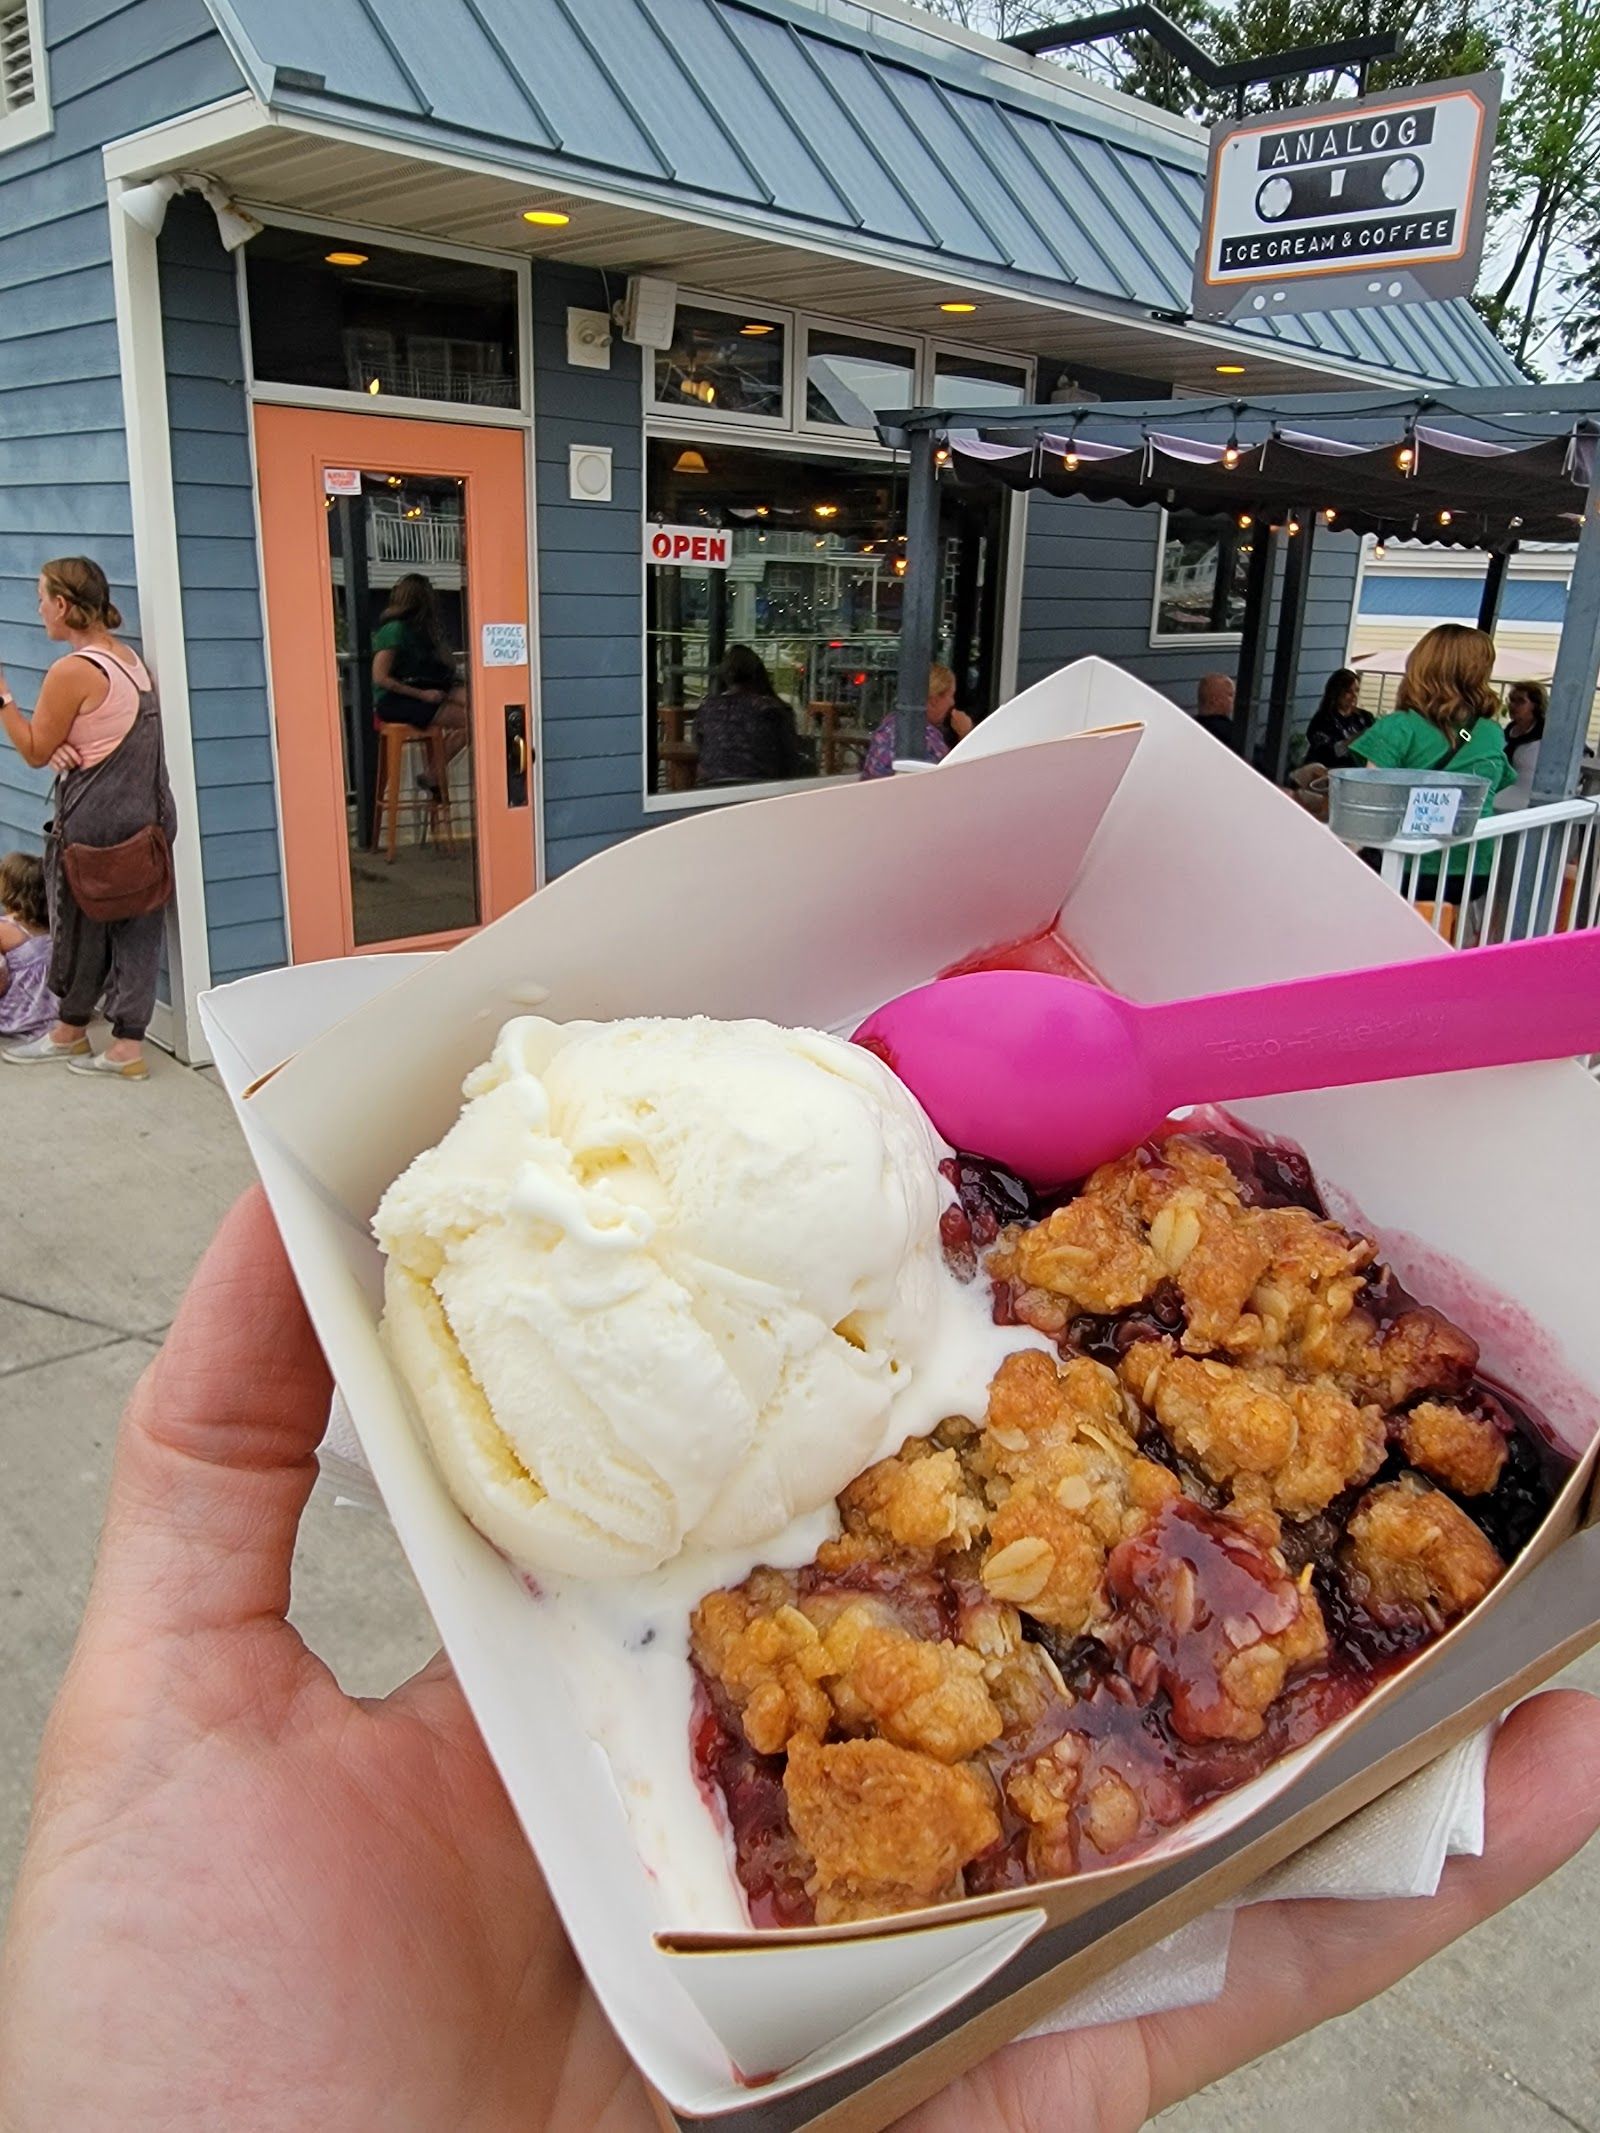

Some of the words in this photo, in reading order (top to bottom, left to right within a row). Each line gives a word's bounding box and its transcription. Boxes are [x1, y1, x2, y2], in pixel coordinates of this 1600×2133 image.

[1271, 115, 1418, 166] ANALOG
[1224, 242, 1261, 263] ICE
[1266, 233, 1335, 257] CREAM
[1341, 231, 1352, 247] &
[1359, 219, 1449, 247] COFFEE
[652, 533, 726, 562] OPEN
